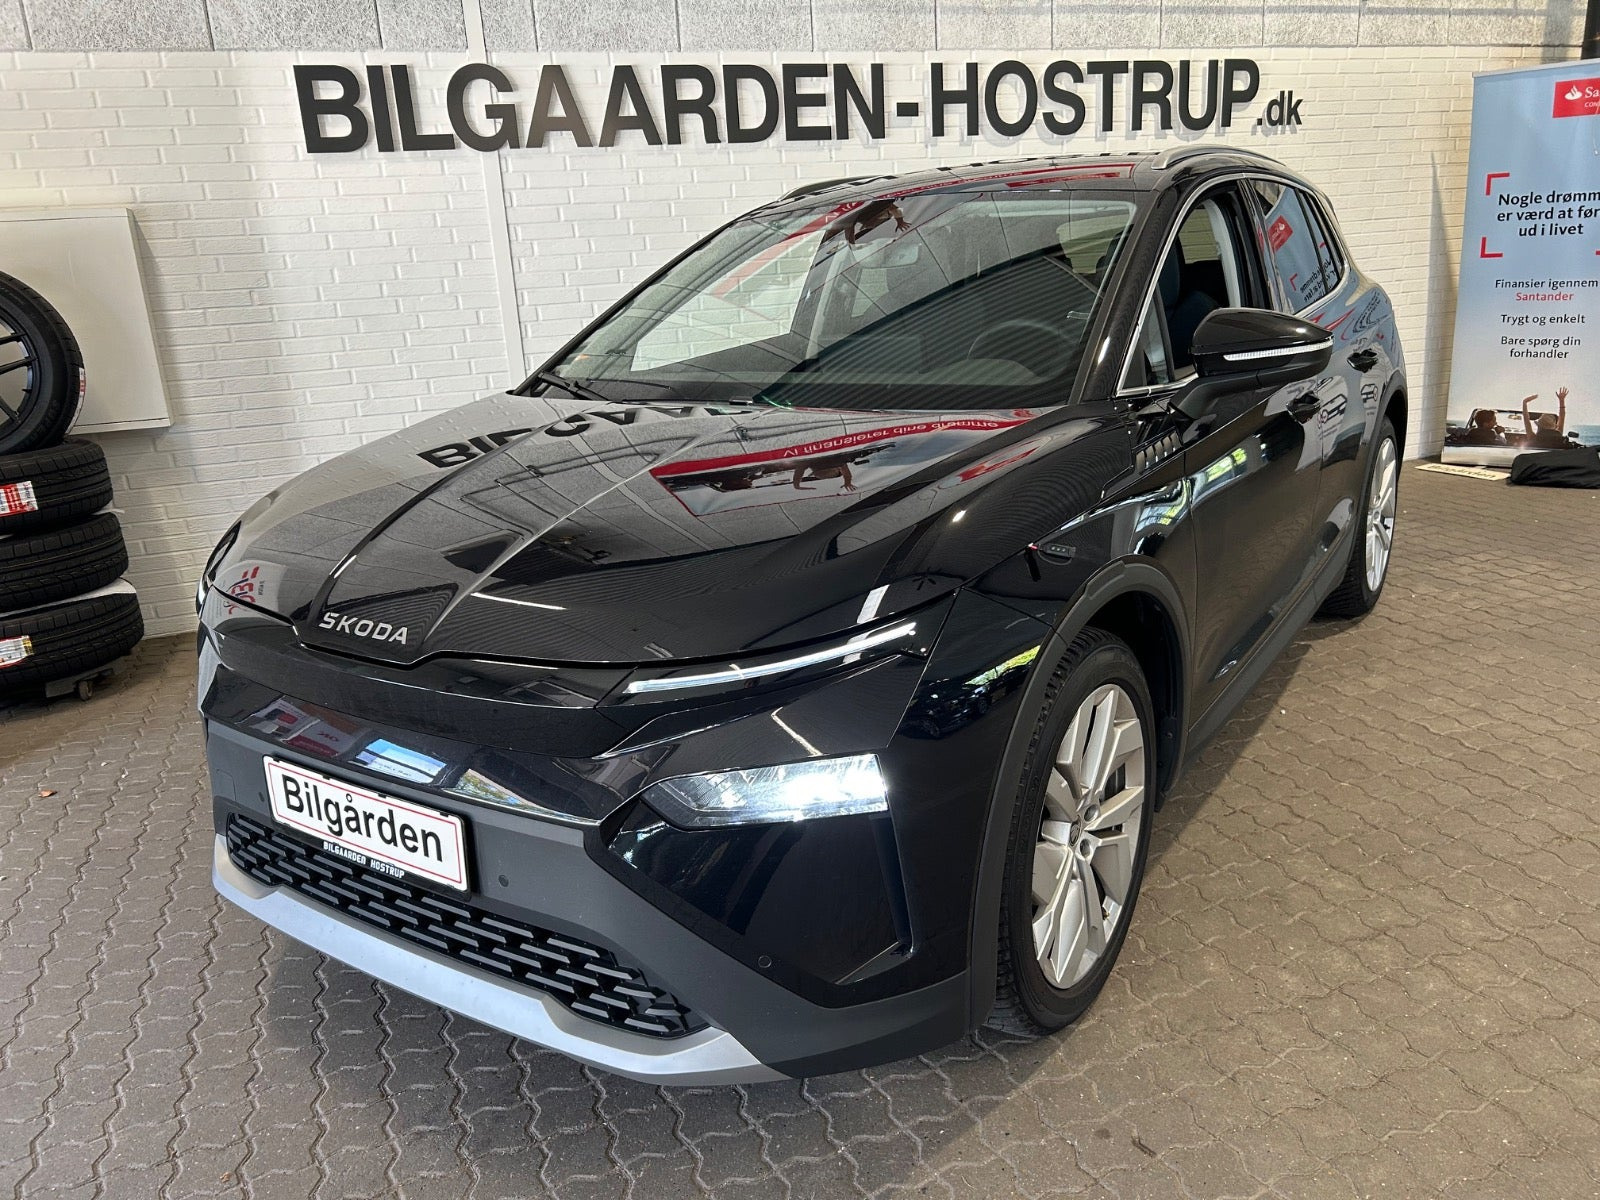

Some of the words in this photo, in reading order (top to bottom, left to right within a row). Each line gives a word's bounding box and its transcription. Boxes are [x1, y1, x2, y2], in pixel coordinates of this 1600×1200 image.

[1498, 191, 1542, 208] Nogle
[1546, 190, 1600, 203] drømm
[1497, 211, 1512, 221] er
[1516, 207, 1554, 221] værd
[1558, 207, 1573, 219] at
[1577, 205, 1600, 218] før
[1519, 223, 1537, 236] ud
[1541, 223, 1546, 236] i
[1549, 223, 1584, 236] livet
[1495, 278, 1545, 289] Finansier
[1548, 278, 1598, 291] igennem
[1515, 291, 1574, 301] Santander
[1500, 314, 1529, 326] Trygt
[1532, 316, 1546, 326] og
[1549, 313, 1586, 324] enkelt
[1501, 336, 1526, 345] Bare
[1528, 337, 1560, 349] spørg
[1562, 336, 1581, 346] din
[1509, 348, 1569, 359] forhandler
[281, 773, 443, 862] Bilgården
[323, 840, 367, 865] BILGAARDEN
[370, 859, 405, 879] HOSTRUP
